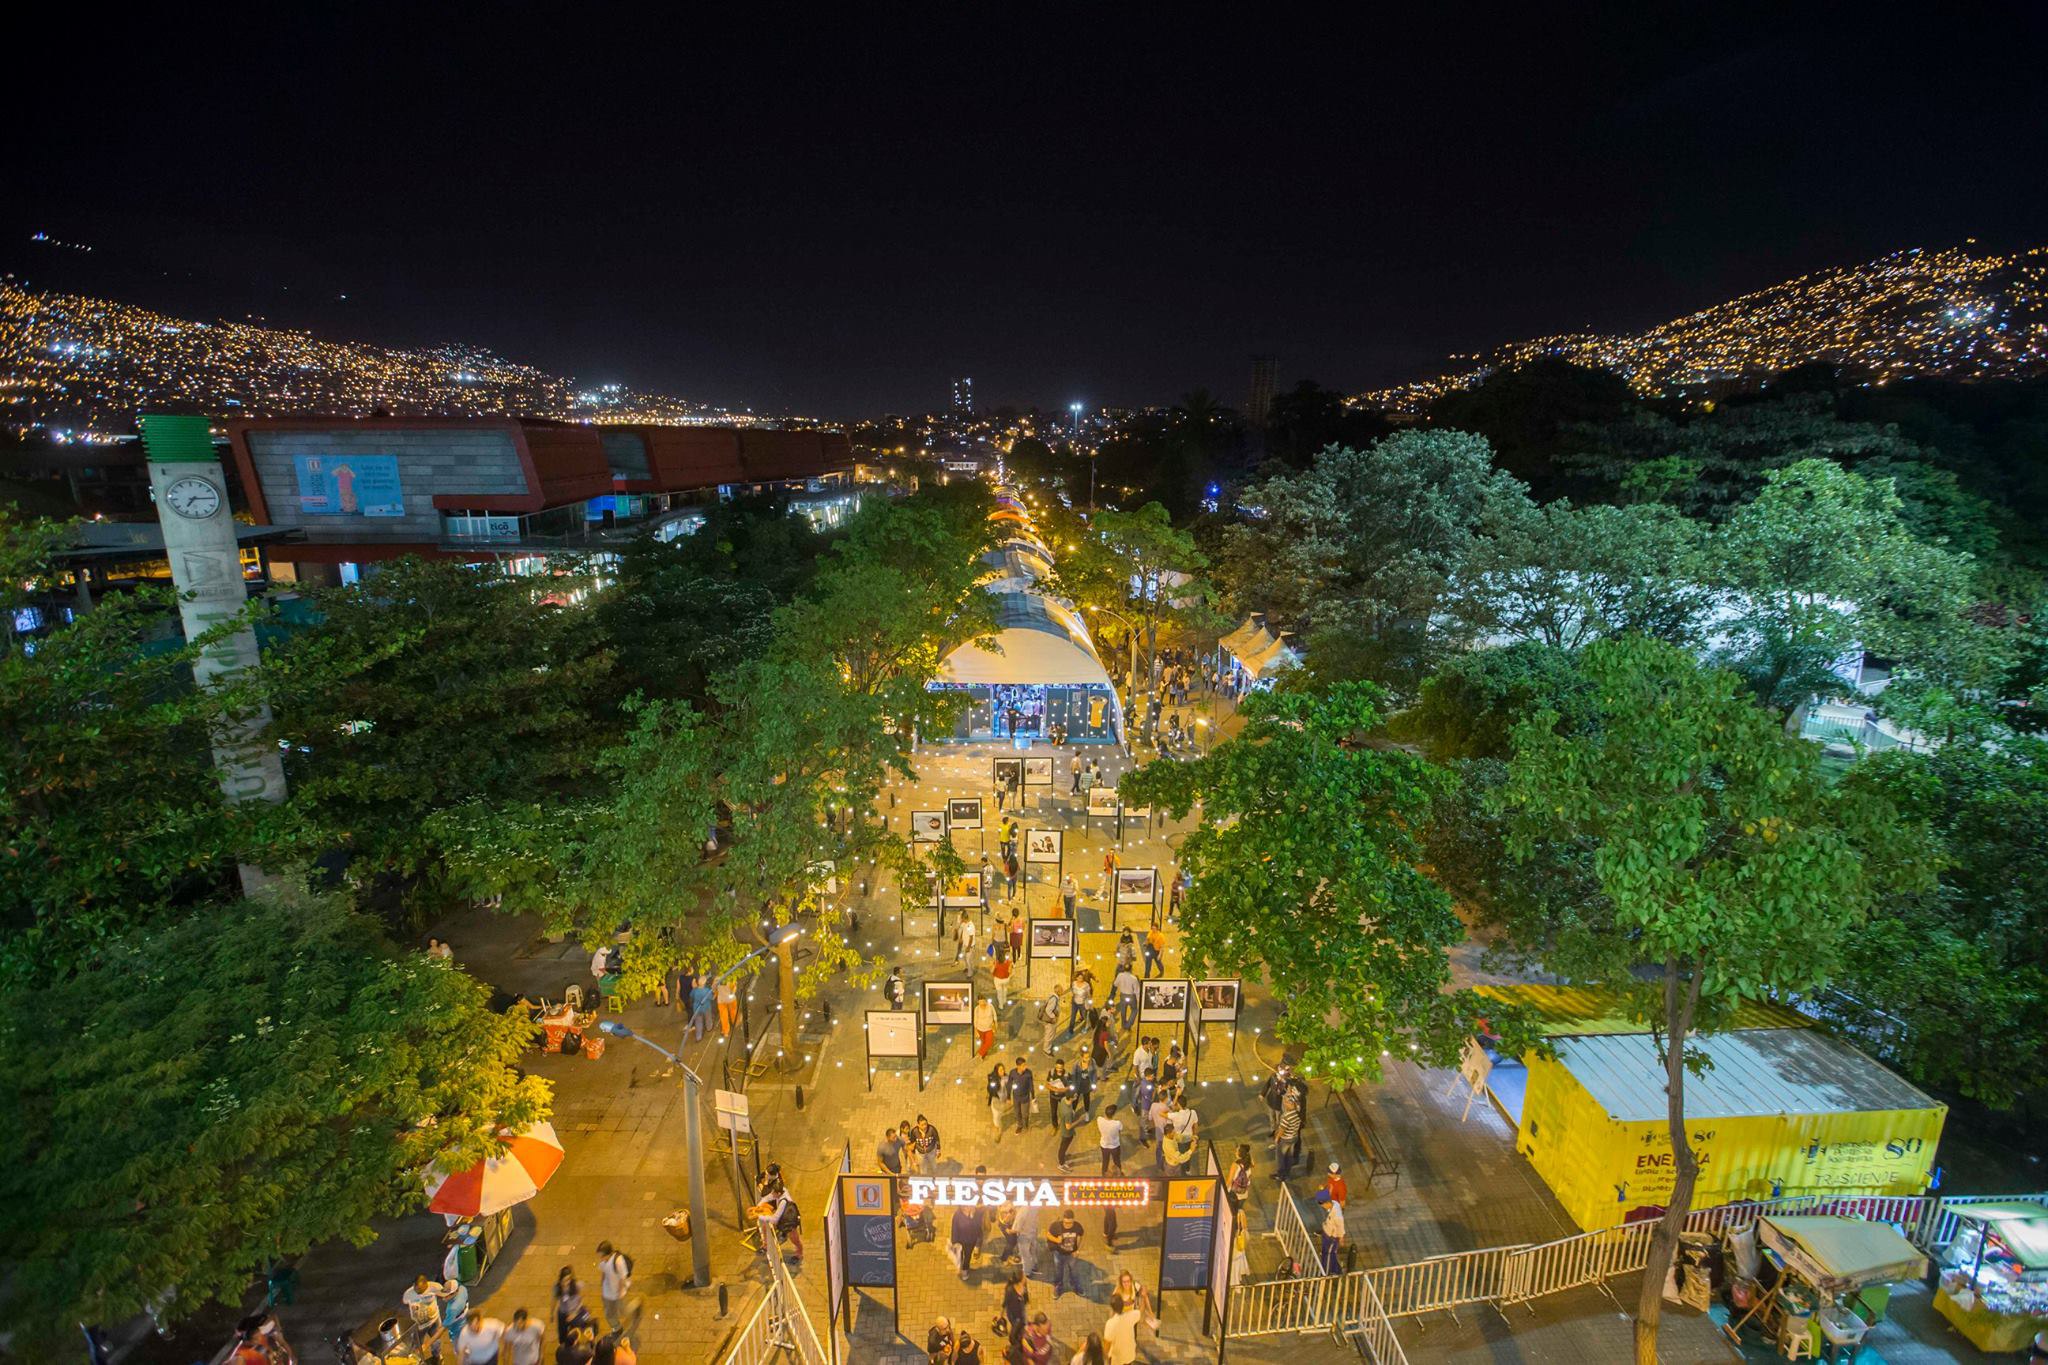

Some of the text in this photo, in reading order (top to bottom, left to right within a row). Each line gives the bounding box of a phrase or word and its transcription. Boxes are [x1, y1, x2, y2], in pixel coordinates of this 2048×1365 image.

[1078, 1183, 1098, 1191] DEL
[909, 1177, 1061, 1206] FIESTA
[1072, 1191, 1141, 1199] Y LA CULTURA
